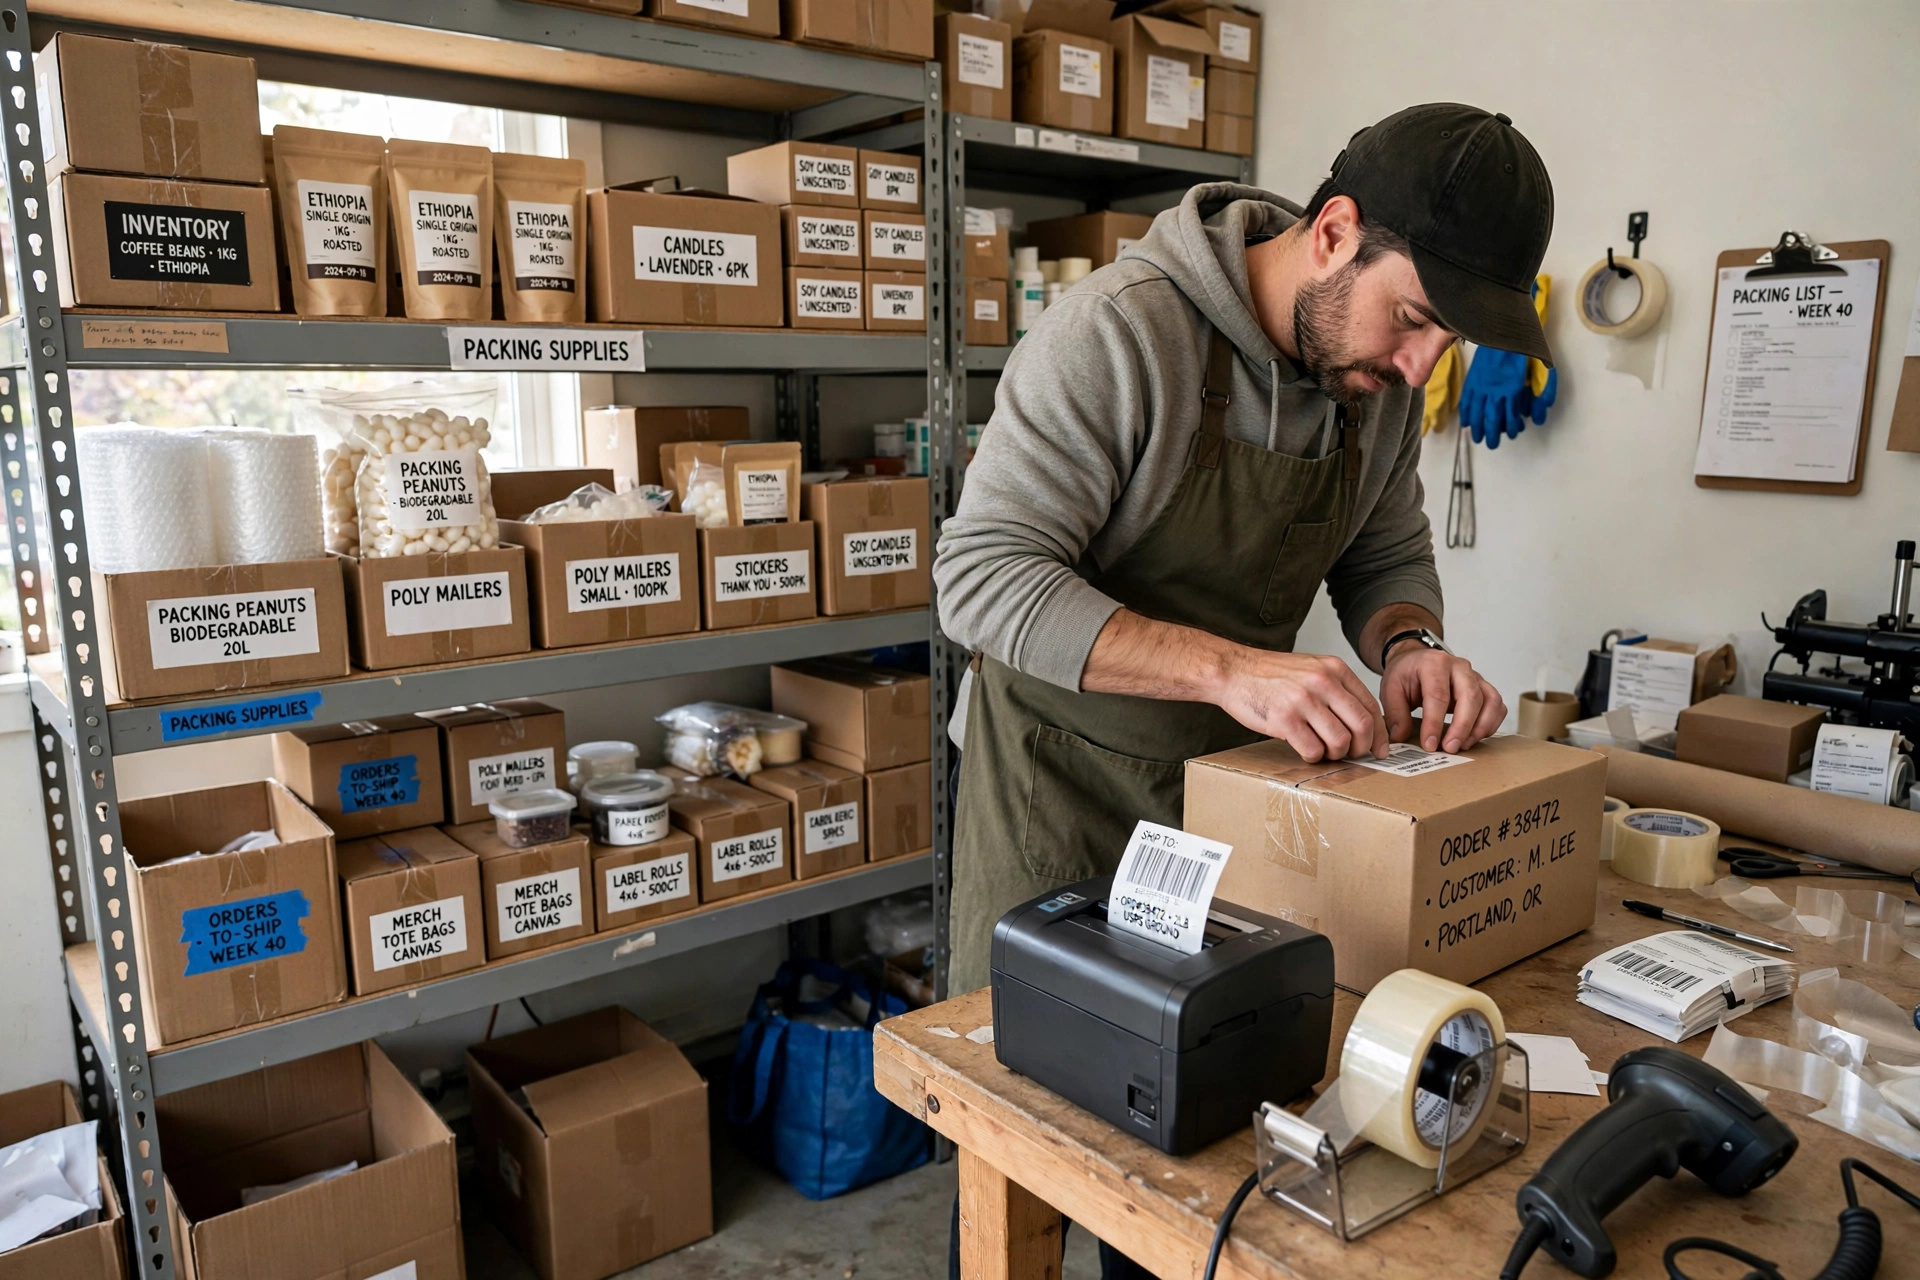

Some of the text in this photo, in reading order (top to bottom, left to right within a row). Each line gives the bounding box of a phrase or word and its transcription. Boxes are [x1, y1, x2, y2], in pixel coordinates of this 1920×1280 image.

[800, 160, 851, 176] SOY CANDLES
[802, 176, 846, 190] UNSCENTED
[308, 192, 368, 211] ETHIOPIA
[418, 202, 474, 220] ETHIOPIA
[122, 213, 230, 240] INVENTORY
[306, 210, 372, 226] SINGLE ORIGIN
[416, 220, 478, 234] SINGLE ORIGIN
[517, 212, 569, 228] ETHIOPIA
[334, 226, 350, 236] 1KG
[443, 234, 458, 244] 1KG
[516, 228, 544, 238] SINGLE
[802, 222, 855, 237] SOY CANDLES
[874, 227, 923, 242] SOY CANDLES
[120, 241, 237, 260] COFFEE BEANS 1KG
[323, 239, 362, 252] ROASTED
[432, 247, 470, 259] ROASTED
[539, 242, 553, 252] 1KG
[663, 236, 724, 257] CANDLES
[805, 238, 849, 251] UNSCENTED
[158, 260, 210, 275] ETHIOPIA
[530, 255, 564, 265] ROASTED
[649, 256, 749, 279] LAVENDER 6PK
[801, 284, 857, 299] SOY CANDLES
[1733, 285, 1825, 304] PACKING LIST
[805, 301, 851, 313] UNSCENTED
[1798, 303, 1853, 318] WEEK 40
[464, 338, 629, 361] PACKING SUPPLIES
[400, 460, 462, 477] PACKING
[403, 477, 466, 494] PEANUTS
[399, 493, 474, 508] BIODEGRADABLE
[426, 509, 448, 521] 20L
[850, 536, 911, 554] SOY CANDLES
[575, 560, 671, 584] POLY MAILERS
[735, 558, 788, 577] STICKERS
[391, 580, 502, 606] POLY MAILERS
[580, 581, 668, 604] SMALL 100PK
[721, 575, 806, 594] THANK YOU 500PK
[159, 597, 306, 624] PACKING PEANUTS
[170, 617, 296, 643] BIODEGRADABLE
[224, 640, 250, 656] 20L
[170, 700, 308, 732] PACKING SUPPLIES
[351, 762, 400, 781] ORDERS
[1163, 836, 1178, 848] TO:
[1440, 799, 1560, 866] ORDER #38472
[718, 836, 777, 859] LABEL ROLLS
[724, 850, 775, 873] 4x6 500CT
[1439, 830, 1576, 909] CUSTOMER: M. LEE
[613, 861, 683, 888] LABEL ROLLS
[515, 880, 558, 901] MERCH
[619, 878, 679, 902] 4x6 500CT
[209, 901, 277, 928] ORDERS
[506, 893, 572, 919] TOTE BAGS
[393, 907, 441, 931] MERCH
[515, 913, 560, 934] CANVAS
[1438, 883, 1542, 953] PORTLAND, OR
[209, 919, 281, 946] TO-SHIP
[382, 921, 456, 948] TOTE BAGS
[210, 936, 286, 964] WEEK 40
[393, 940, 442, 962] CANVAS
